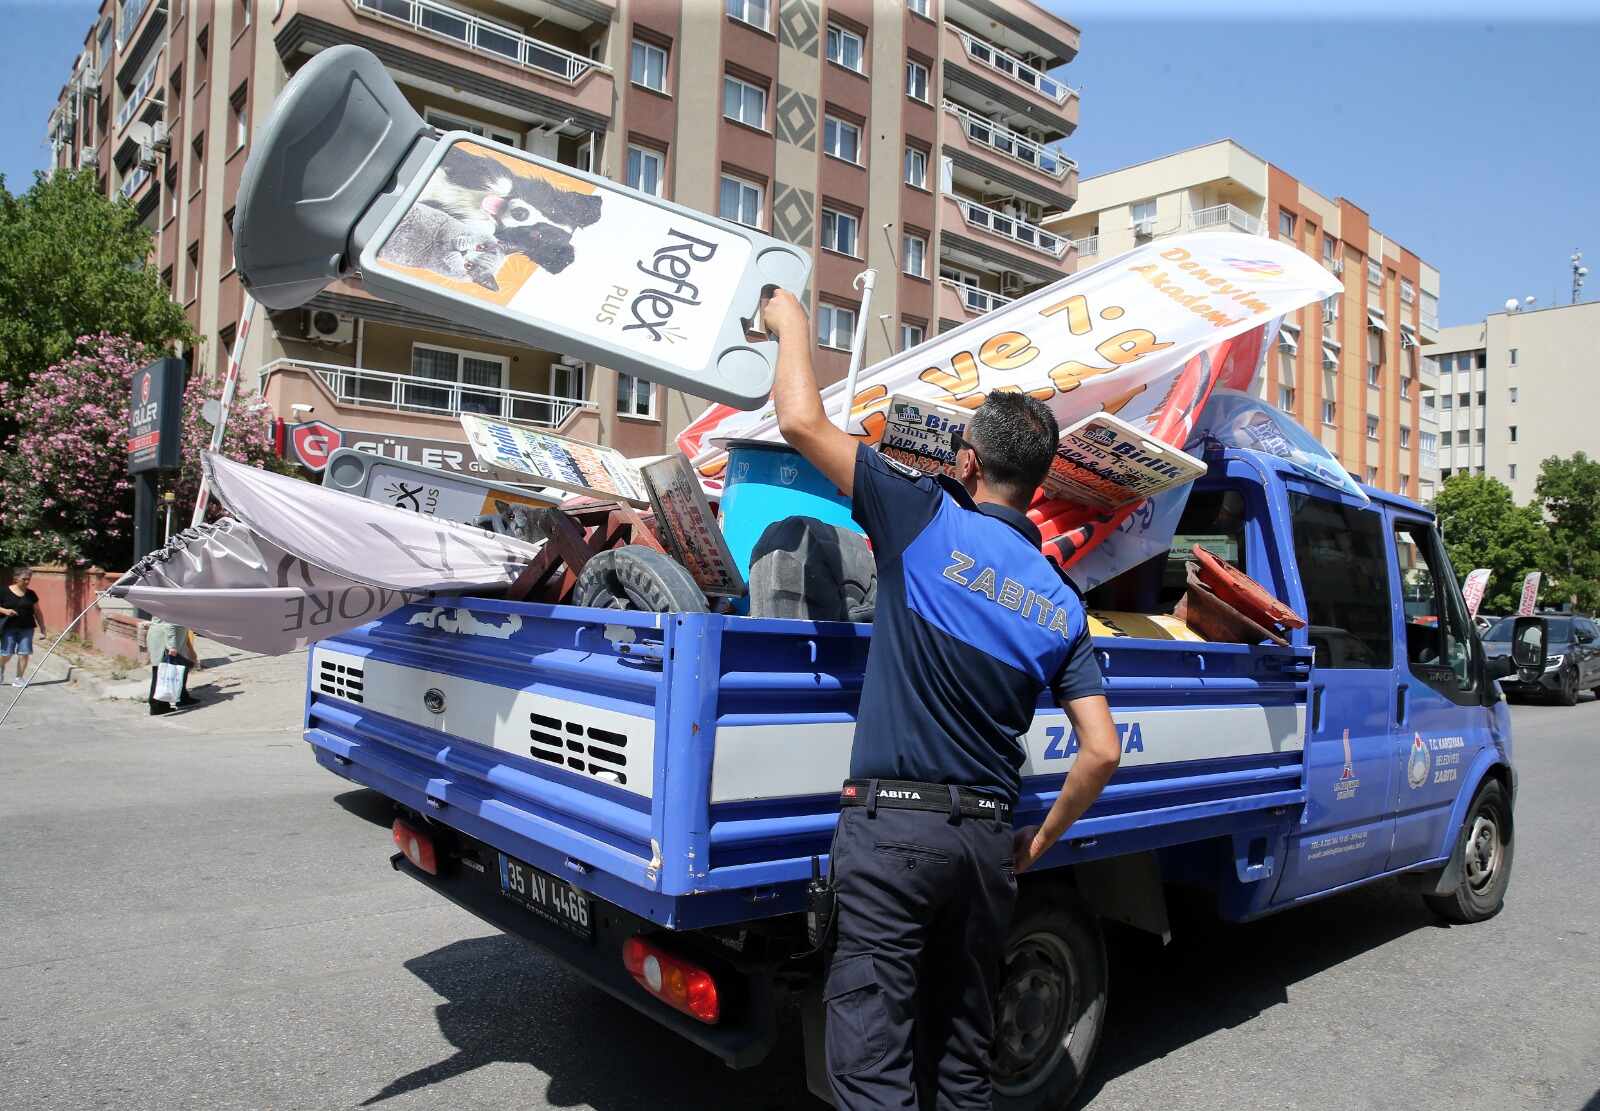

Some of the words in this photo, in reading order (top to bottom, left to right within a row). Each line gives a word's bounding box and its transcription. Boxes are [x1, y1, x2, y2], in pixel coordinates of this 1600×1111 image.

[622, 227, 719, 342] Reflex
[595, 284, 628, 326] PLUS
[925, 414, 965, 438] Birl
[353, 438, 463, 471] GÜLER
[1112, 441, 1184, 479] Birlik
[424, 488, 440, 516] LUS
[942, 550, 1069, 639] ZABITA
[1044, 722, 1144, 761] ZATA
[978, 799, 1009, 811] ZATA
[508, 862, 525, 894] 35
[552, 882, 588, 927] 4466
